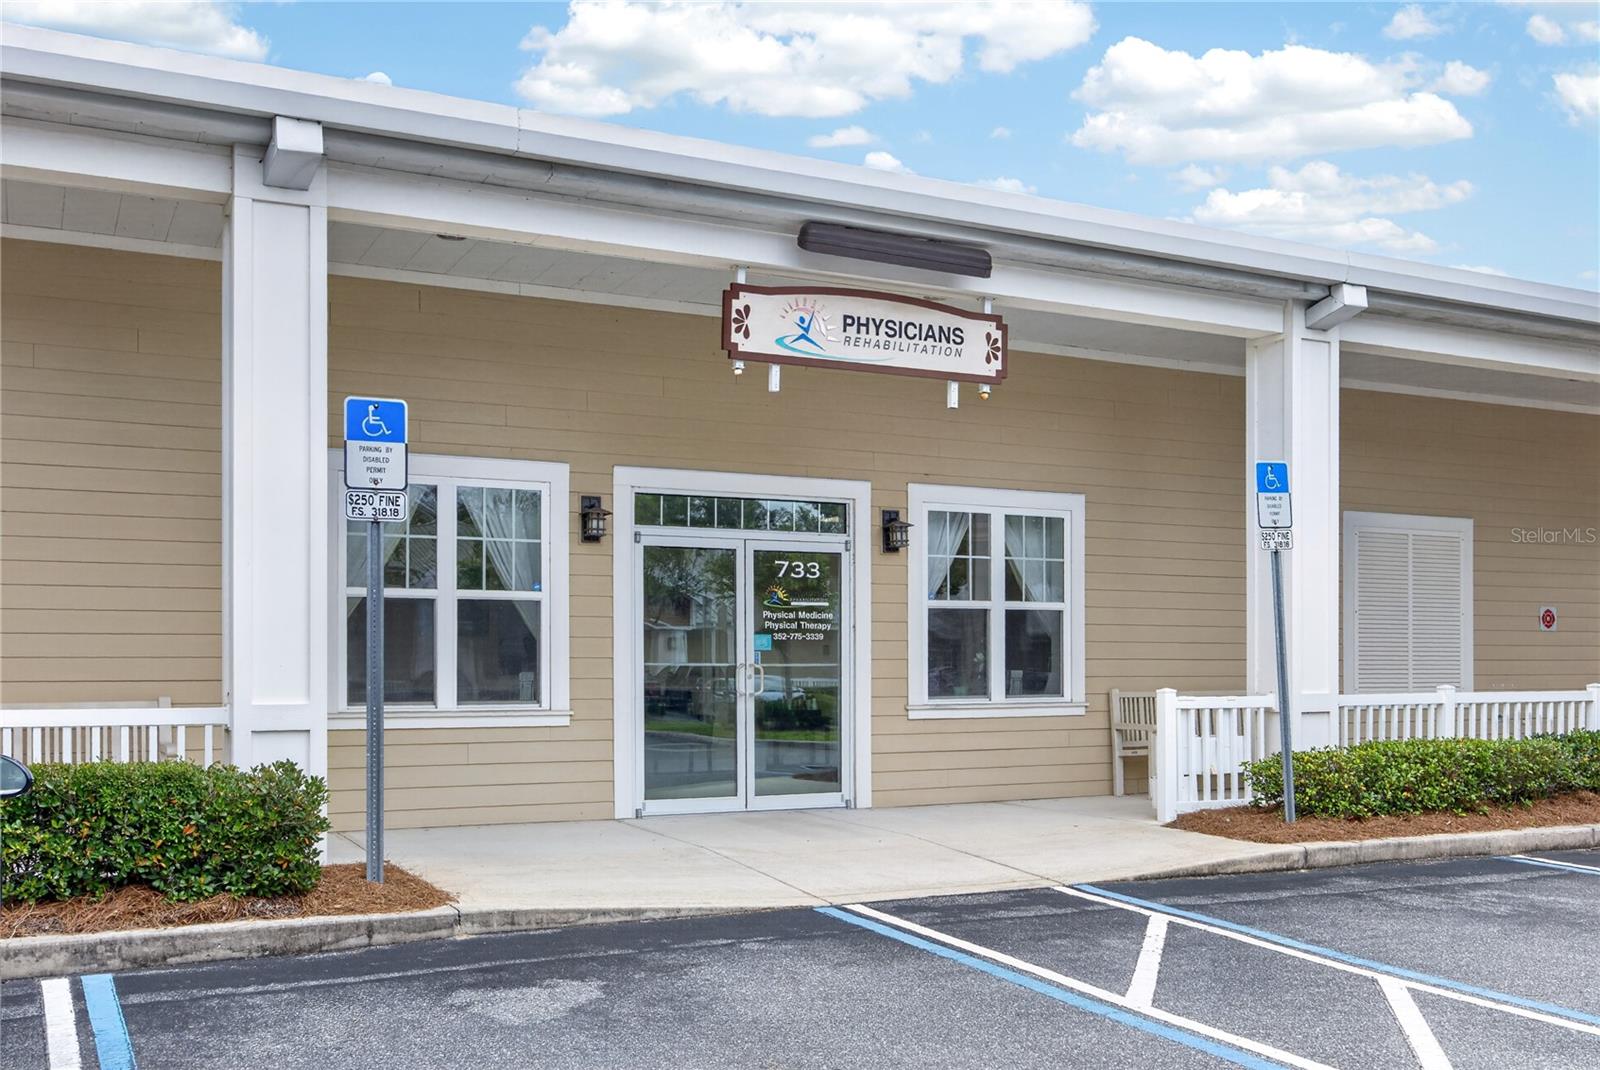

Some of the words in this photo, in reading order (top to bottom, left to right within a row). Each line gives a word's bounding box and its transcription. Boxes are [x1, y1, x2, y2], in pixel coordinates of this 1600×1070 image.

[842, 314, 964, 346] PHYSICIANS
[843, 336, 963, 358] REHABILITATION
[359, 445, 382, 453] PARKING
[363, 455, 390, 463] DISABLED
[366, 466, 386, 474] PERMIT
[348, 493, 374, 506] $250
[379, 495, 401, 507] FINE
[371, 507, 399, 517] 318.18
[1277, 532, 1290, 541] FINE
[774, 560, 820, 578] 733
[762, 610, 795, 620] Physical
[798, 610, 833, 620] Medicine
[765, 621, 798, 630] Physical
[800, 621, 832, 631] Therapy
